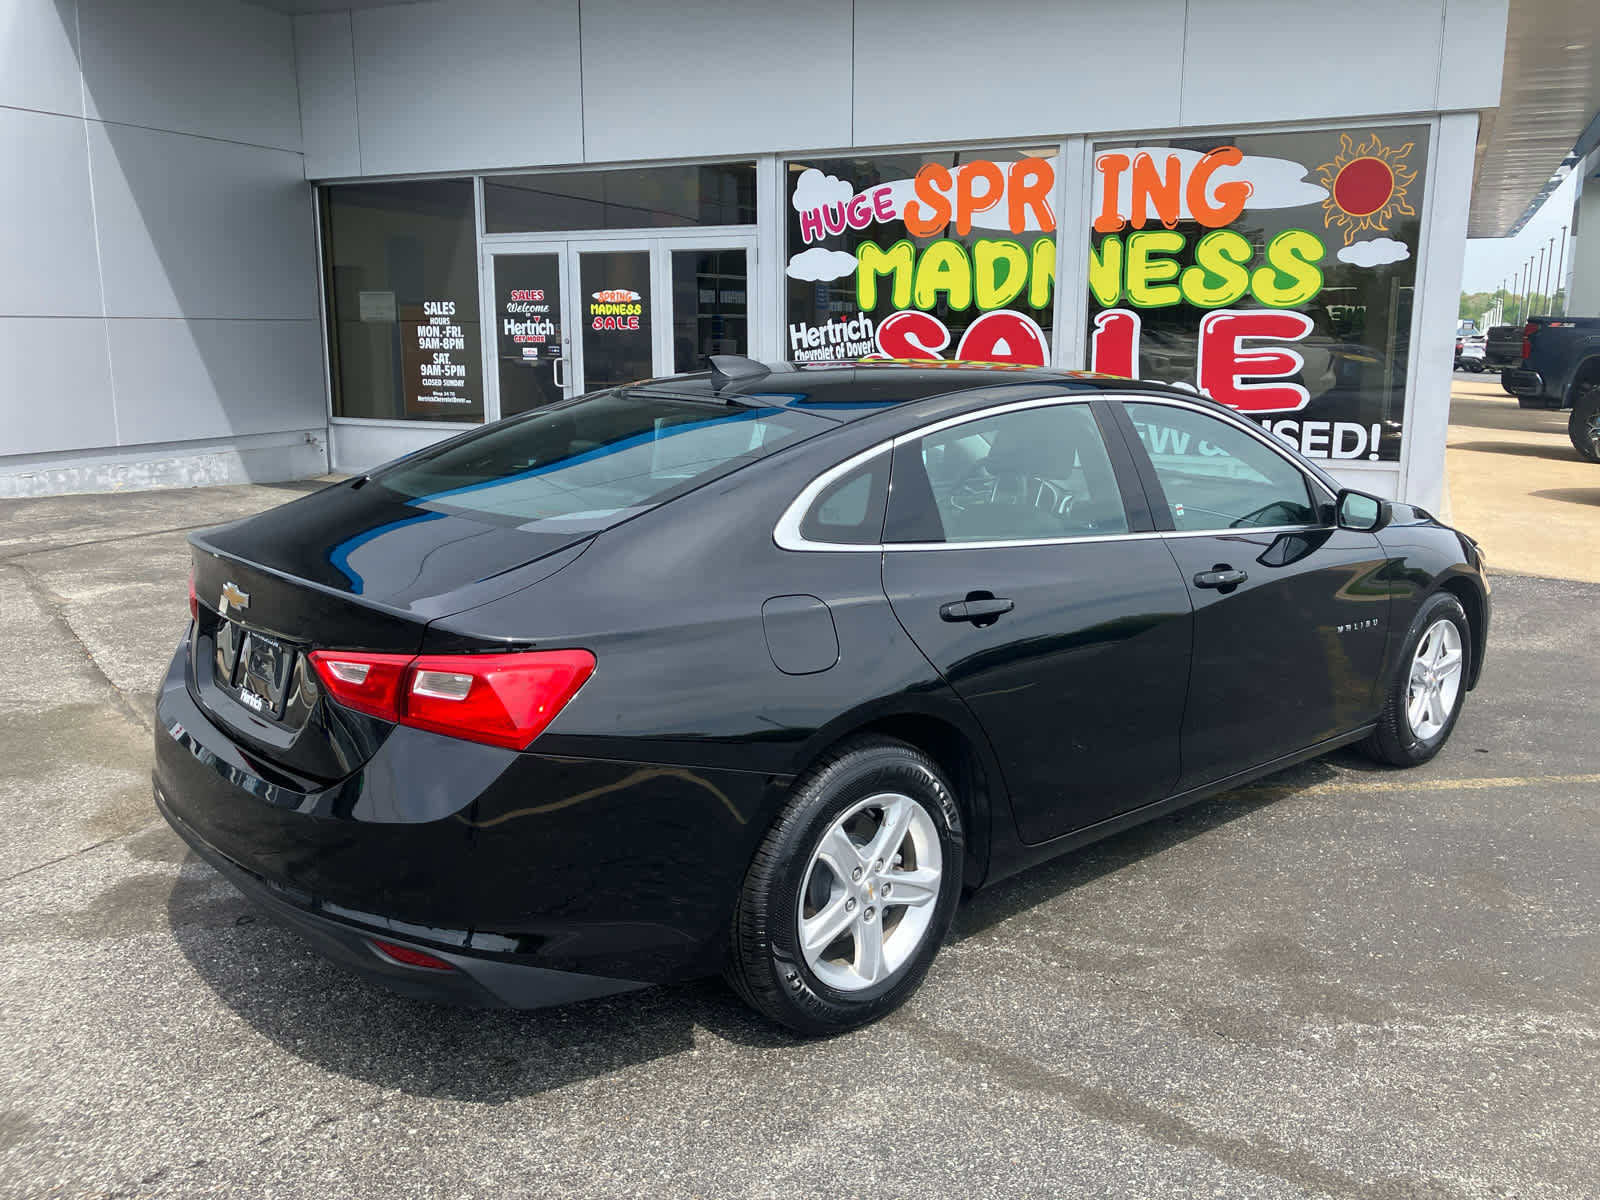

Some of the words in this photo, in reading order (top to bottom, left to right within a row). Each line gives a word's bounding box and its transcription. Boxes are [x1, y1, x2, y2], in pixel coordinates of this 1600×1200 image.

[800, 187, 896, 244] HUGE
[904, 146, 1253, 238] SPRING
[856, 229, 1327, 311] MADNESS
[511, 290, 544, 301] SALES
[598, 290, 632, 303] SPRING
[424, 301, 456, 315] SALES
[506, 302, 550, 313] Welcome
[591, 304, 641, 315] MADNESS
[430, 317, 450, 325] HOURS
[504, 316, 555, 335] Hertrich
[592, 316, 639, 330] SALE
[789, 311, 874, 350] Hertrich
[419, 338, 464, 350] 9AM-8PM
[527, 335, 545, 343] MORE
[836, 342, 845, 359] of
[847, 338, 875, 357] Dover!
[433, 353, 451, 364] SAT.
[420, 364, 466, 376] 9AM-5PM
